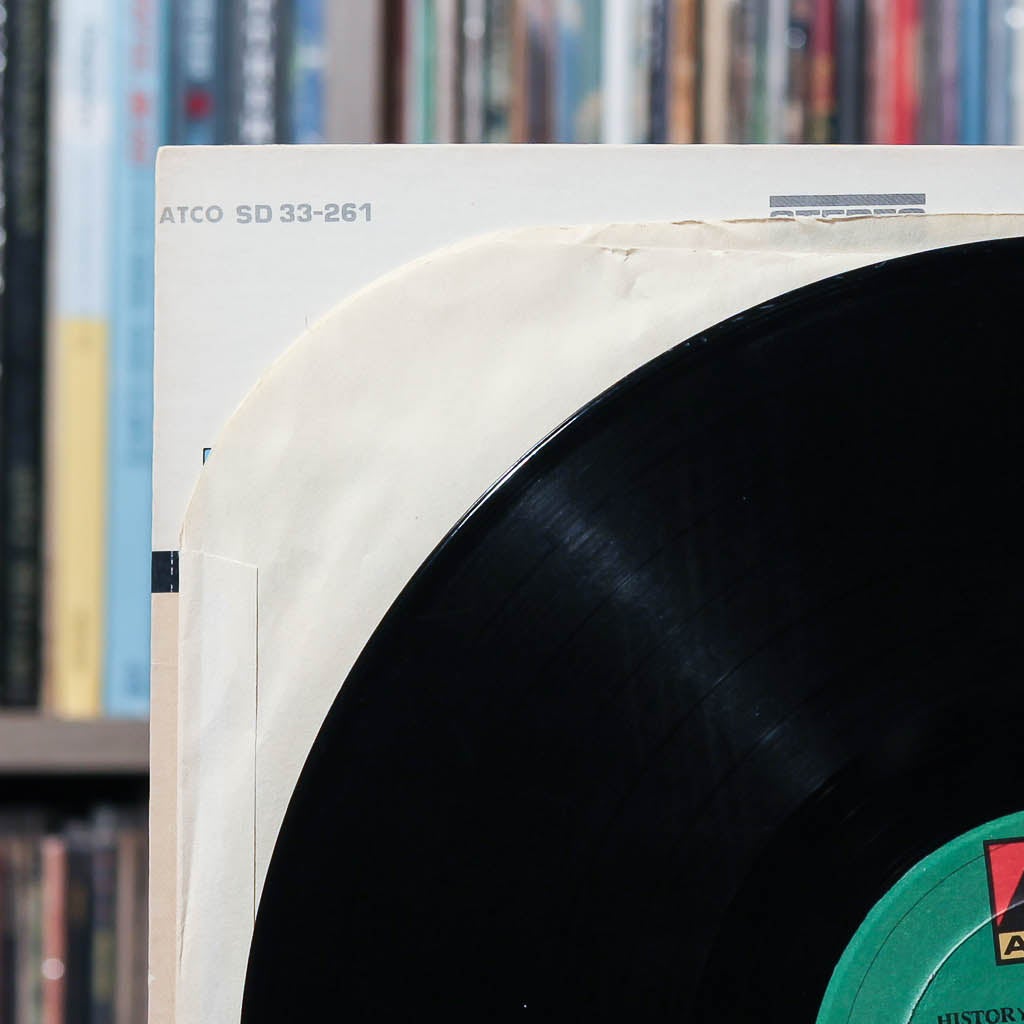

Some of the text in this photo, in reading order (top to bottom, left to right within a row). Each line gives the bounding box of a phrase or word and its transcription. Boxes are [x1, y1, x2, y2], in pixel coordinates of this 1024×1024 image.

[159, 203, 372, 223] ATCO SD 33-261
